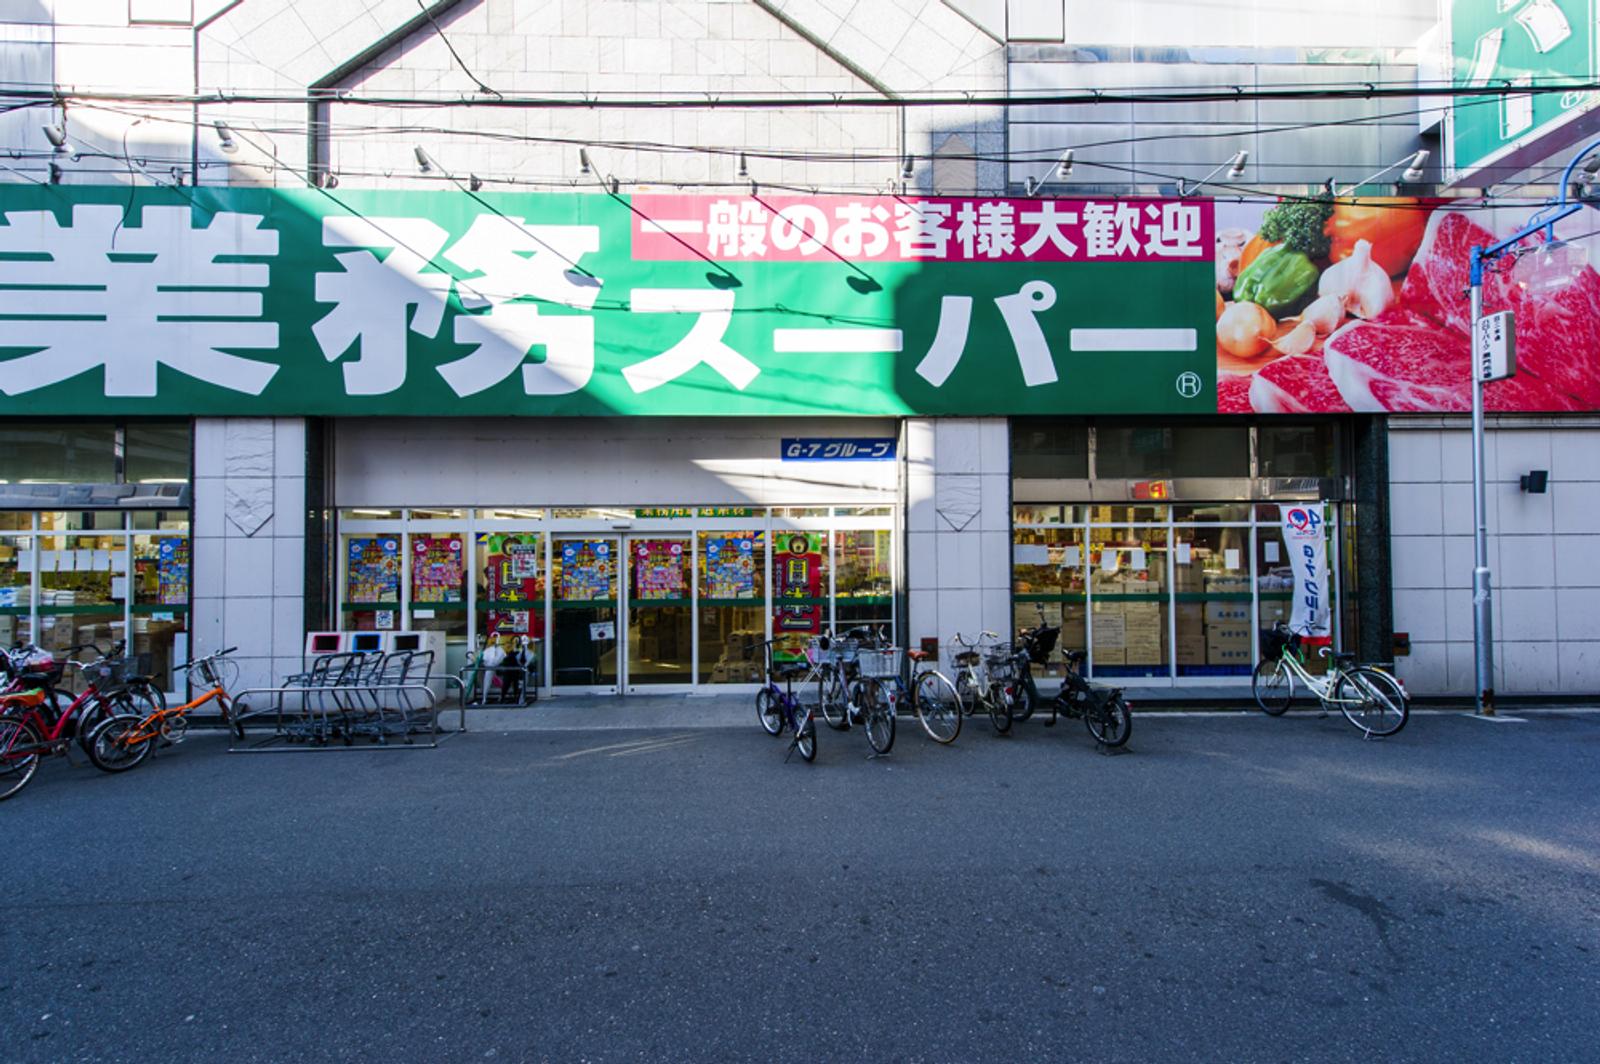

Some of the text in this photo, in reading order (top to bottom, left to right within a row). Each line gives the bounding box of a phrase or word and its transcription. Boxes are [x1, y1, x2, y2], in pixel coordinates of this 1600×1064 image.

[640, 200, 1203, 258] 一般のお客様大歓迎
[0, 204, 1198, 398] 業務スーパー
